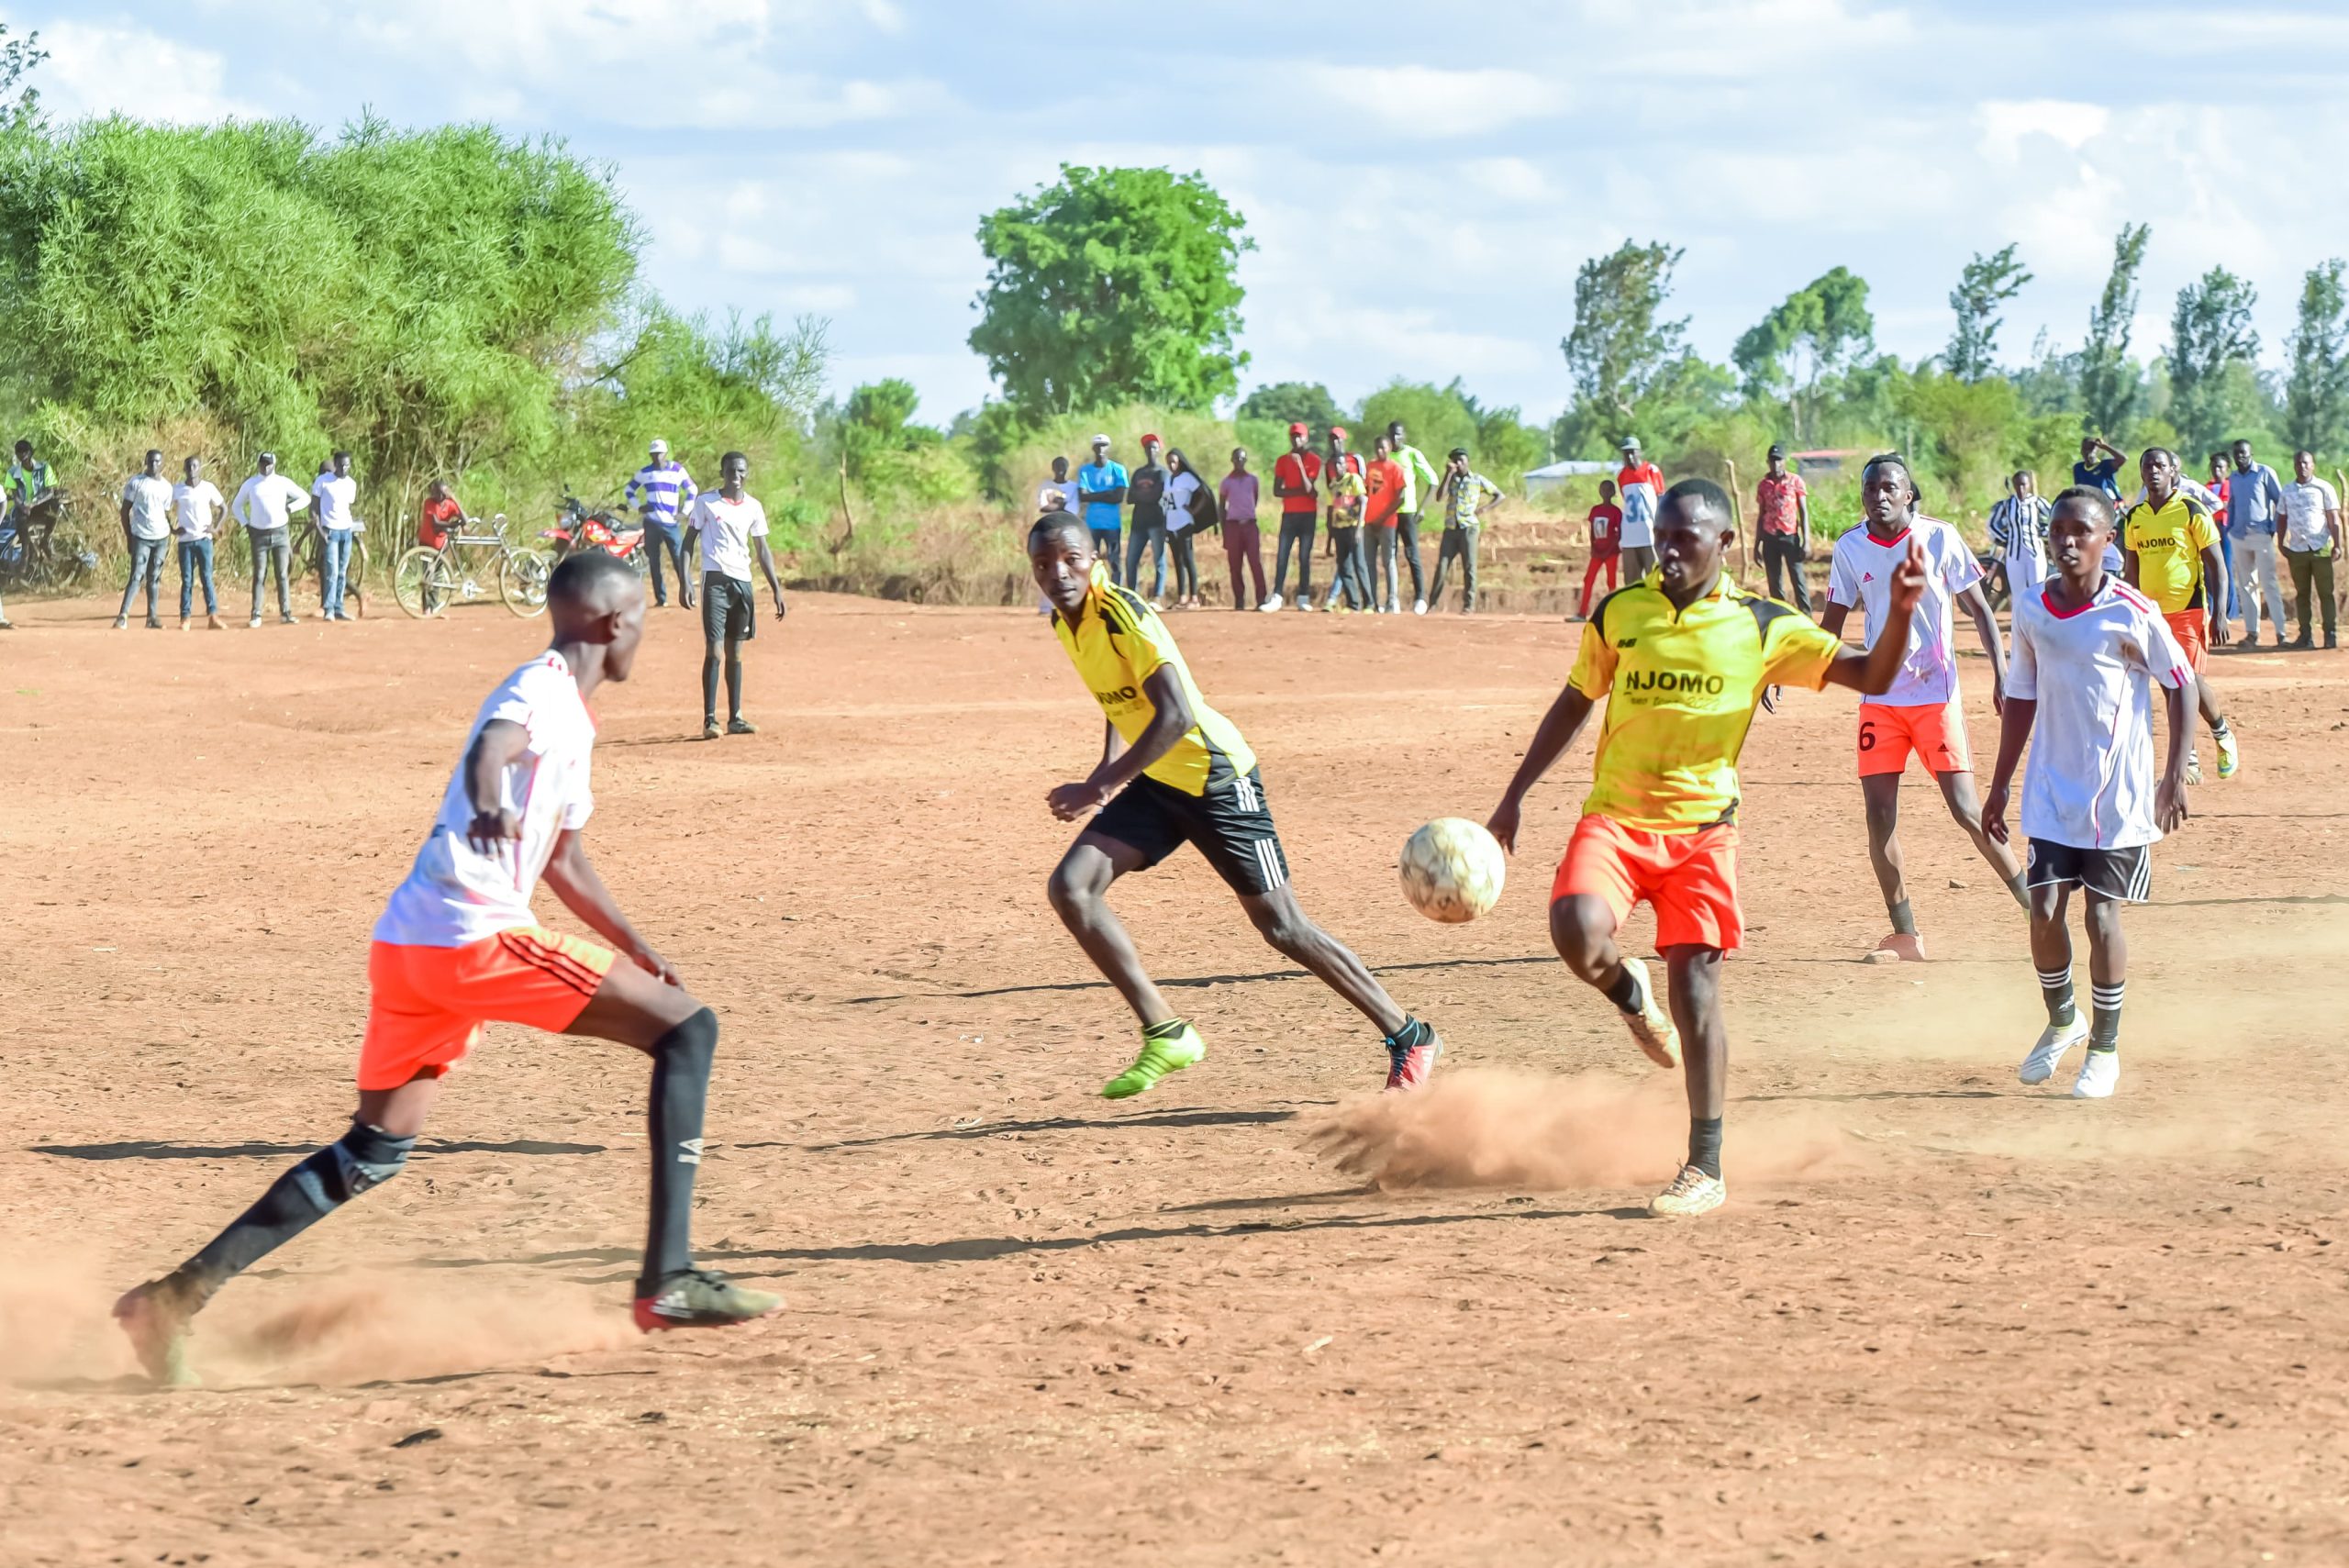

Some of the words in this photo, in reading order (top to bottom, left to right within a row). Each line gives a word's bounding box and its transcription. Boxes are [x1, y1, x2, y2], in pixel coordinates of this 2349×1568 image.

[2137, 538, 2176, 549] NJOMO
[1626, 670, 1724, 695] NJOMO
[1860, 722, 1876, 751] 6
